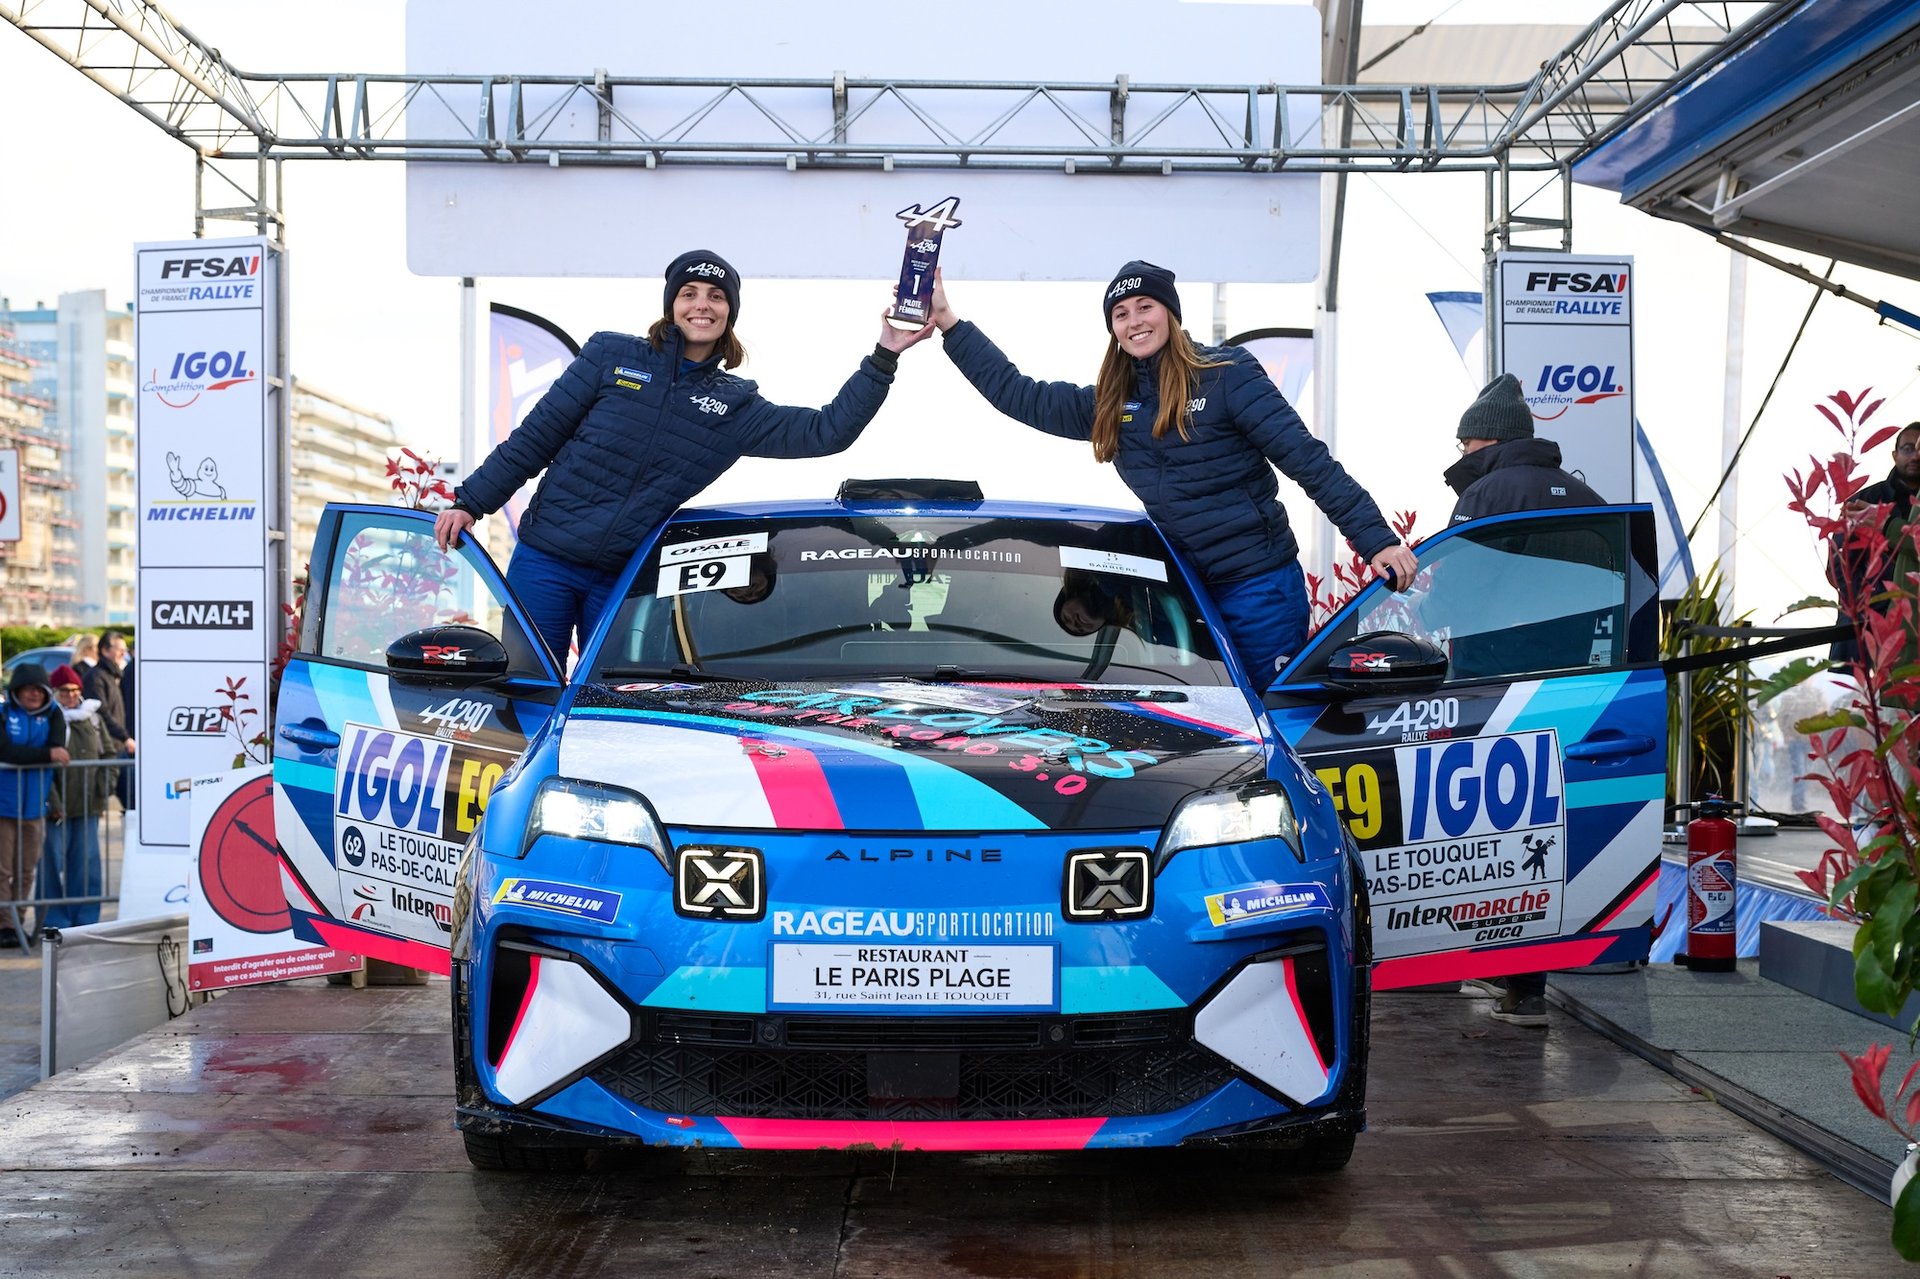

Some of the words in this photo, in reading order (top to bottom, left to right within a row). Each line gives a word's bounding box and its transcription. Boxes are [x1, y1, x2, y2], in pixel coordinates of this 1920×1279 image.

[161, 257, 248, 279] FFSA
[913, 274, 921, 295] 1
[1526, 272, 1615, 292] FFSA
[141, 287, 189, 295] CHAMPIONNAT
[189, 285, 254, 300] RALLYE
[903, 299, 922, 309] PILOTE
[1555, 301, 1621, 314] RALLYE
[142, 380, 205, 395] Compétition
[1525, 392, 1573, 407] mpétition
[147, 506, 255, 521] MICHELIN
[671, 540, 751, 556] OPALE
[679, 562, 727, 591] E9
[155, 604, 250, 625] CANAL+
[418, 698, 494, 733] A290
[1366, 697, 1459, 735] A290
[338, 728, 449, 834] IGOL
[1409, 734, 1560, 841] IGOL
[345, 834, 362, 858] 62
[380, 831, 397, 851] LE
[825, 848, 1002, 862] ALPINE
[1375, 853, 1400, 872] LE
[1401, 839, 1501, 868] TOUQUET
[371, 852, 458, 888] PAS-DE-CAL
[526, 890, 604, 912] MICHELIN
[1246, 892, 1317, 911] MICHELIN
[1475, 925, 1524, 942] CUCQ
[213, 962, 241, 973] Interdit
[241, 958, 275, 970] d'agrafer
[286, 955, 296, 964] de
[296, 953, 317, 963] coller
[318, 950, 335, 962] quoi
[857, 949, 969, 962] RESTAURANT
[224, 972, 239, 983] que
[239, 972, 248, 980] ce
[248, 969, 263, 979] soit
[287, 963, 324, 975] panneaux
[815, 968, 842, 986] LE
[852, 968, 920, 987] PARIS
[930, 968, 1011, 987] PLAGE
[814, 991, 831, 1001] 31,
[860, 991, 892, 1000] Saint
[895, 991, 922, 1001] Jean
[926, 992, 940, 1000] LE
[945, 992, 1011, 1002] TOUQUET
